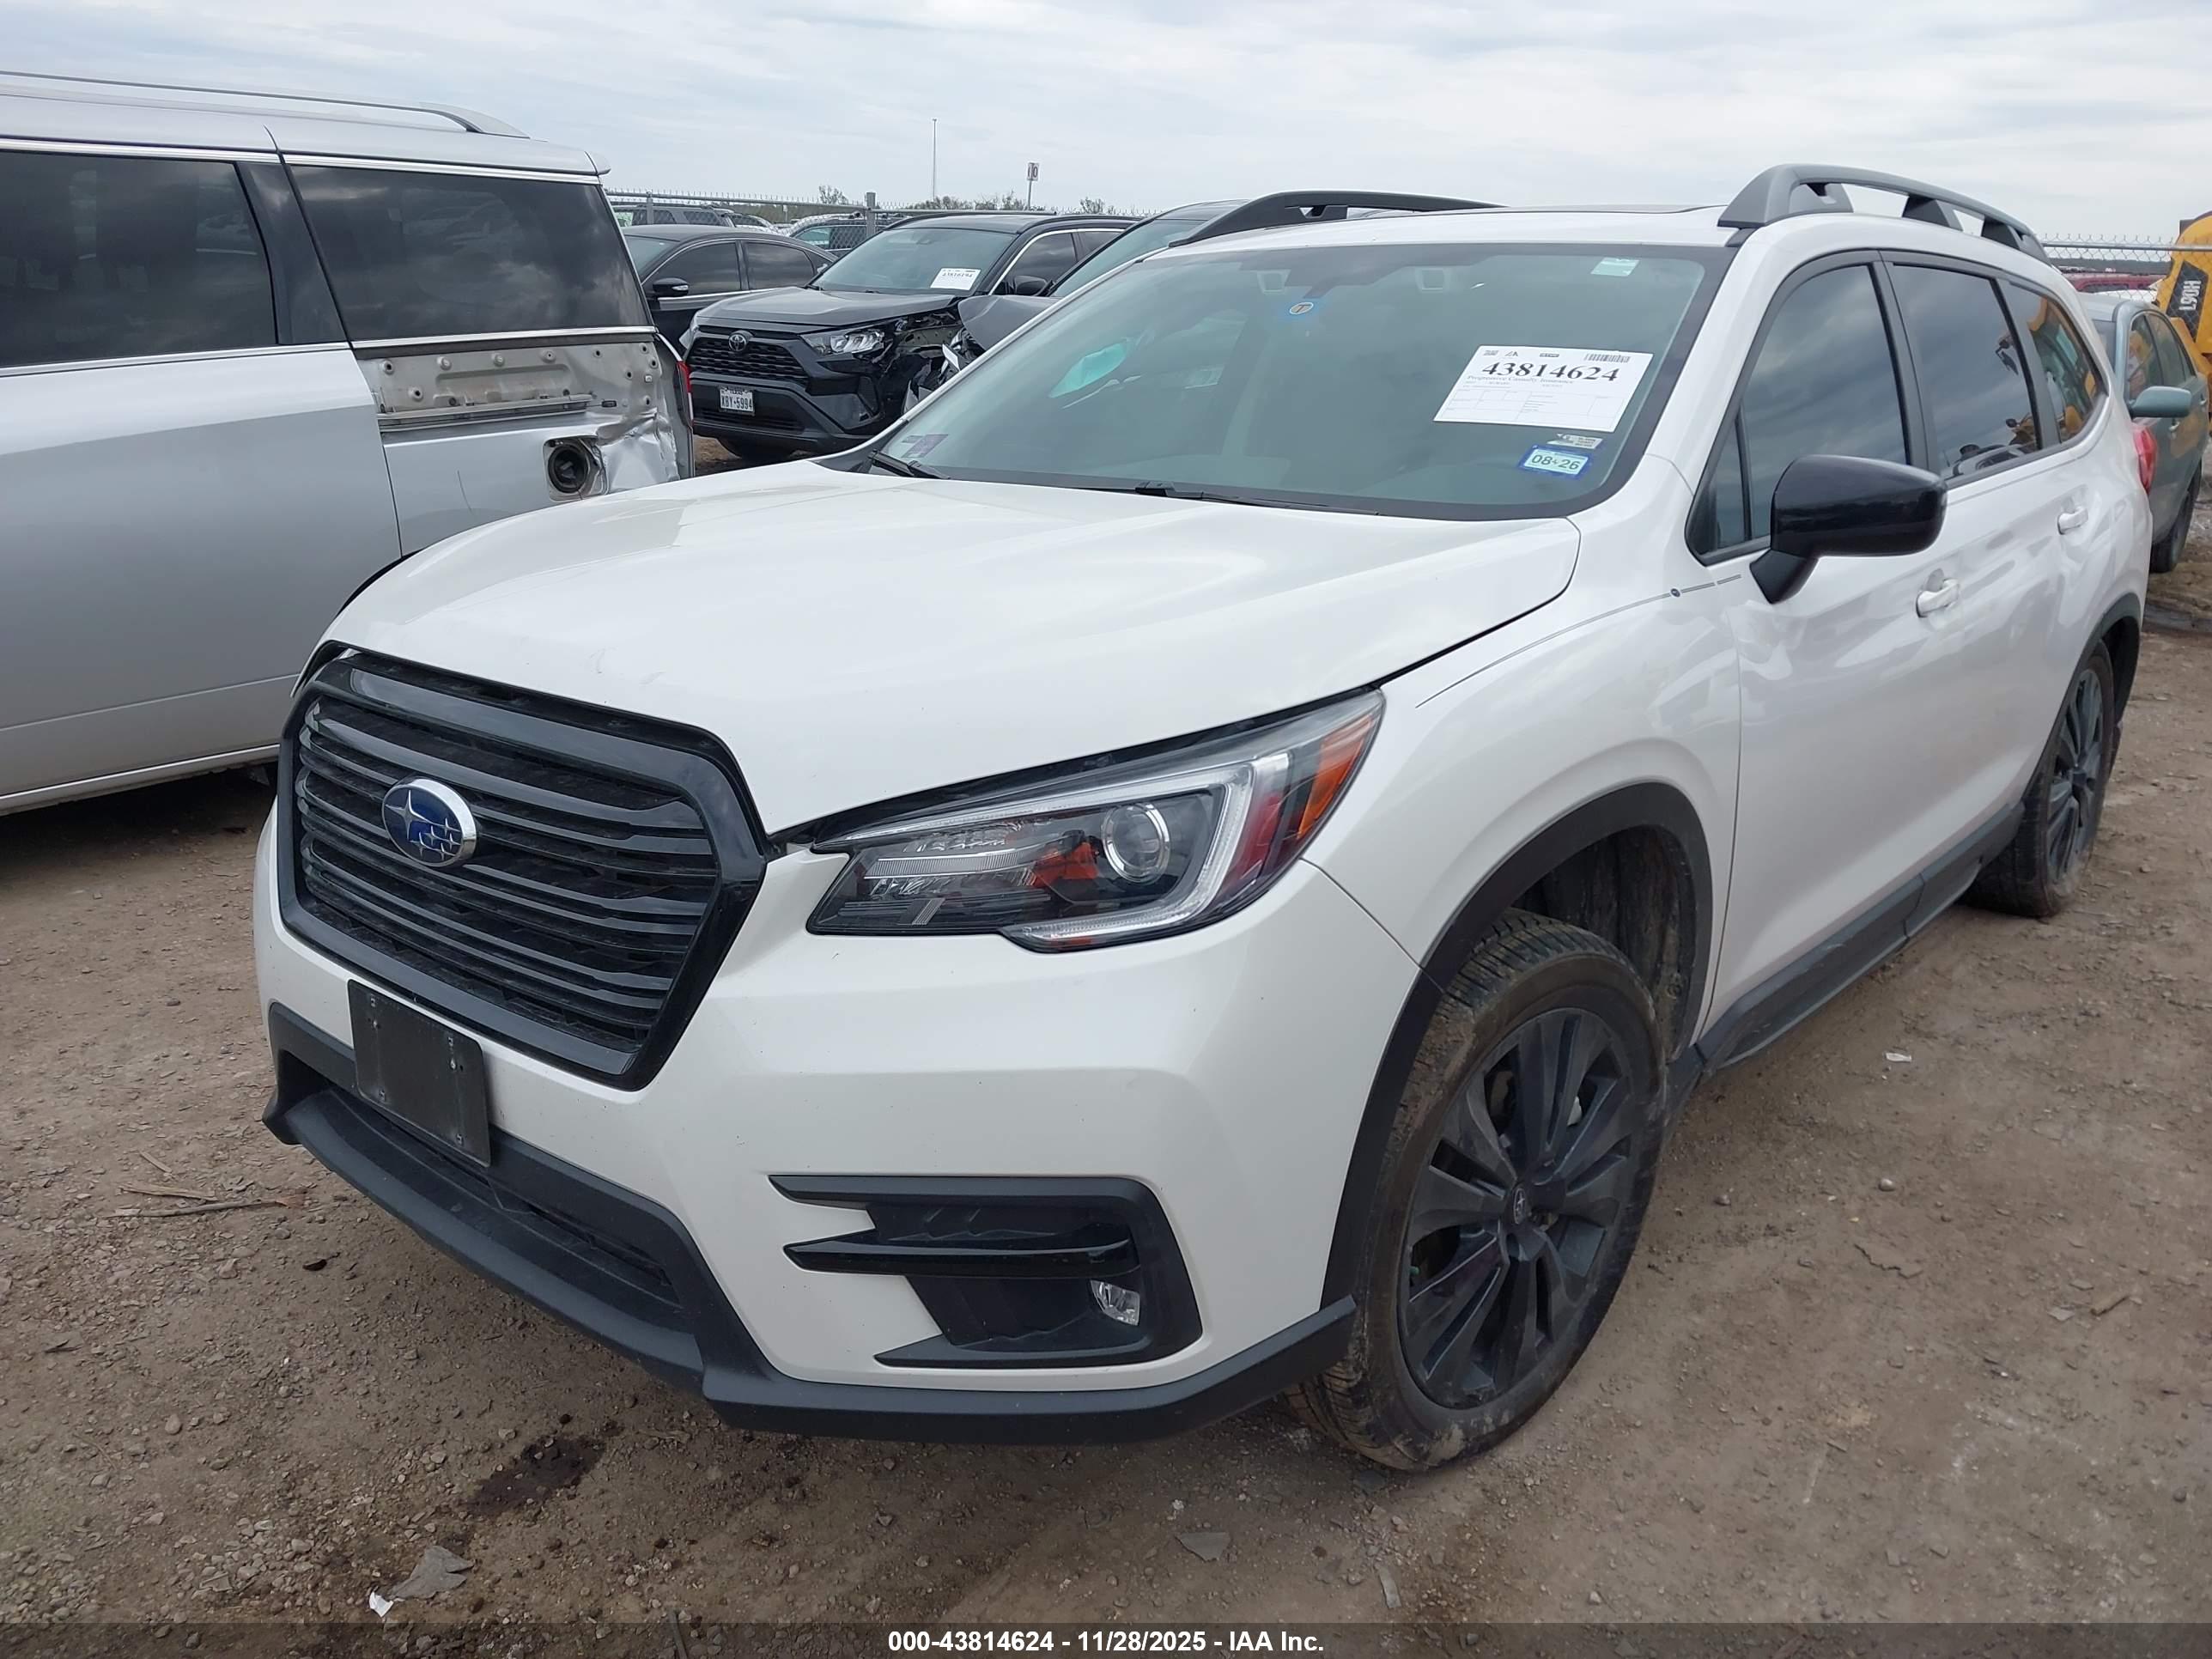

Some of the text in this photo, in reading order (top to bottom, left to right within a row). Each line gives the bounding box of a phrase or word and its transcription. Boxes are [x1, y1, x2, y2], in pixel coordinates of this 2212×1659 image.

[2179, 281, 2201, 310] L90H
[1482, 362, 1620, 381] 43814624
[1531, 454, 1580, 470] 08 26
